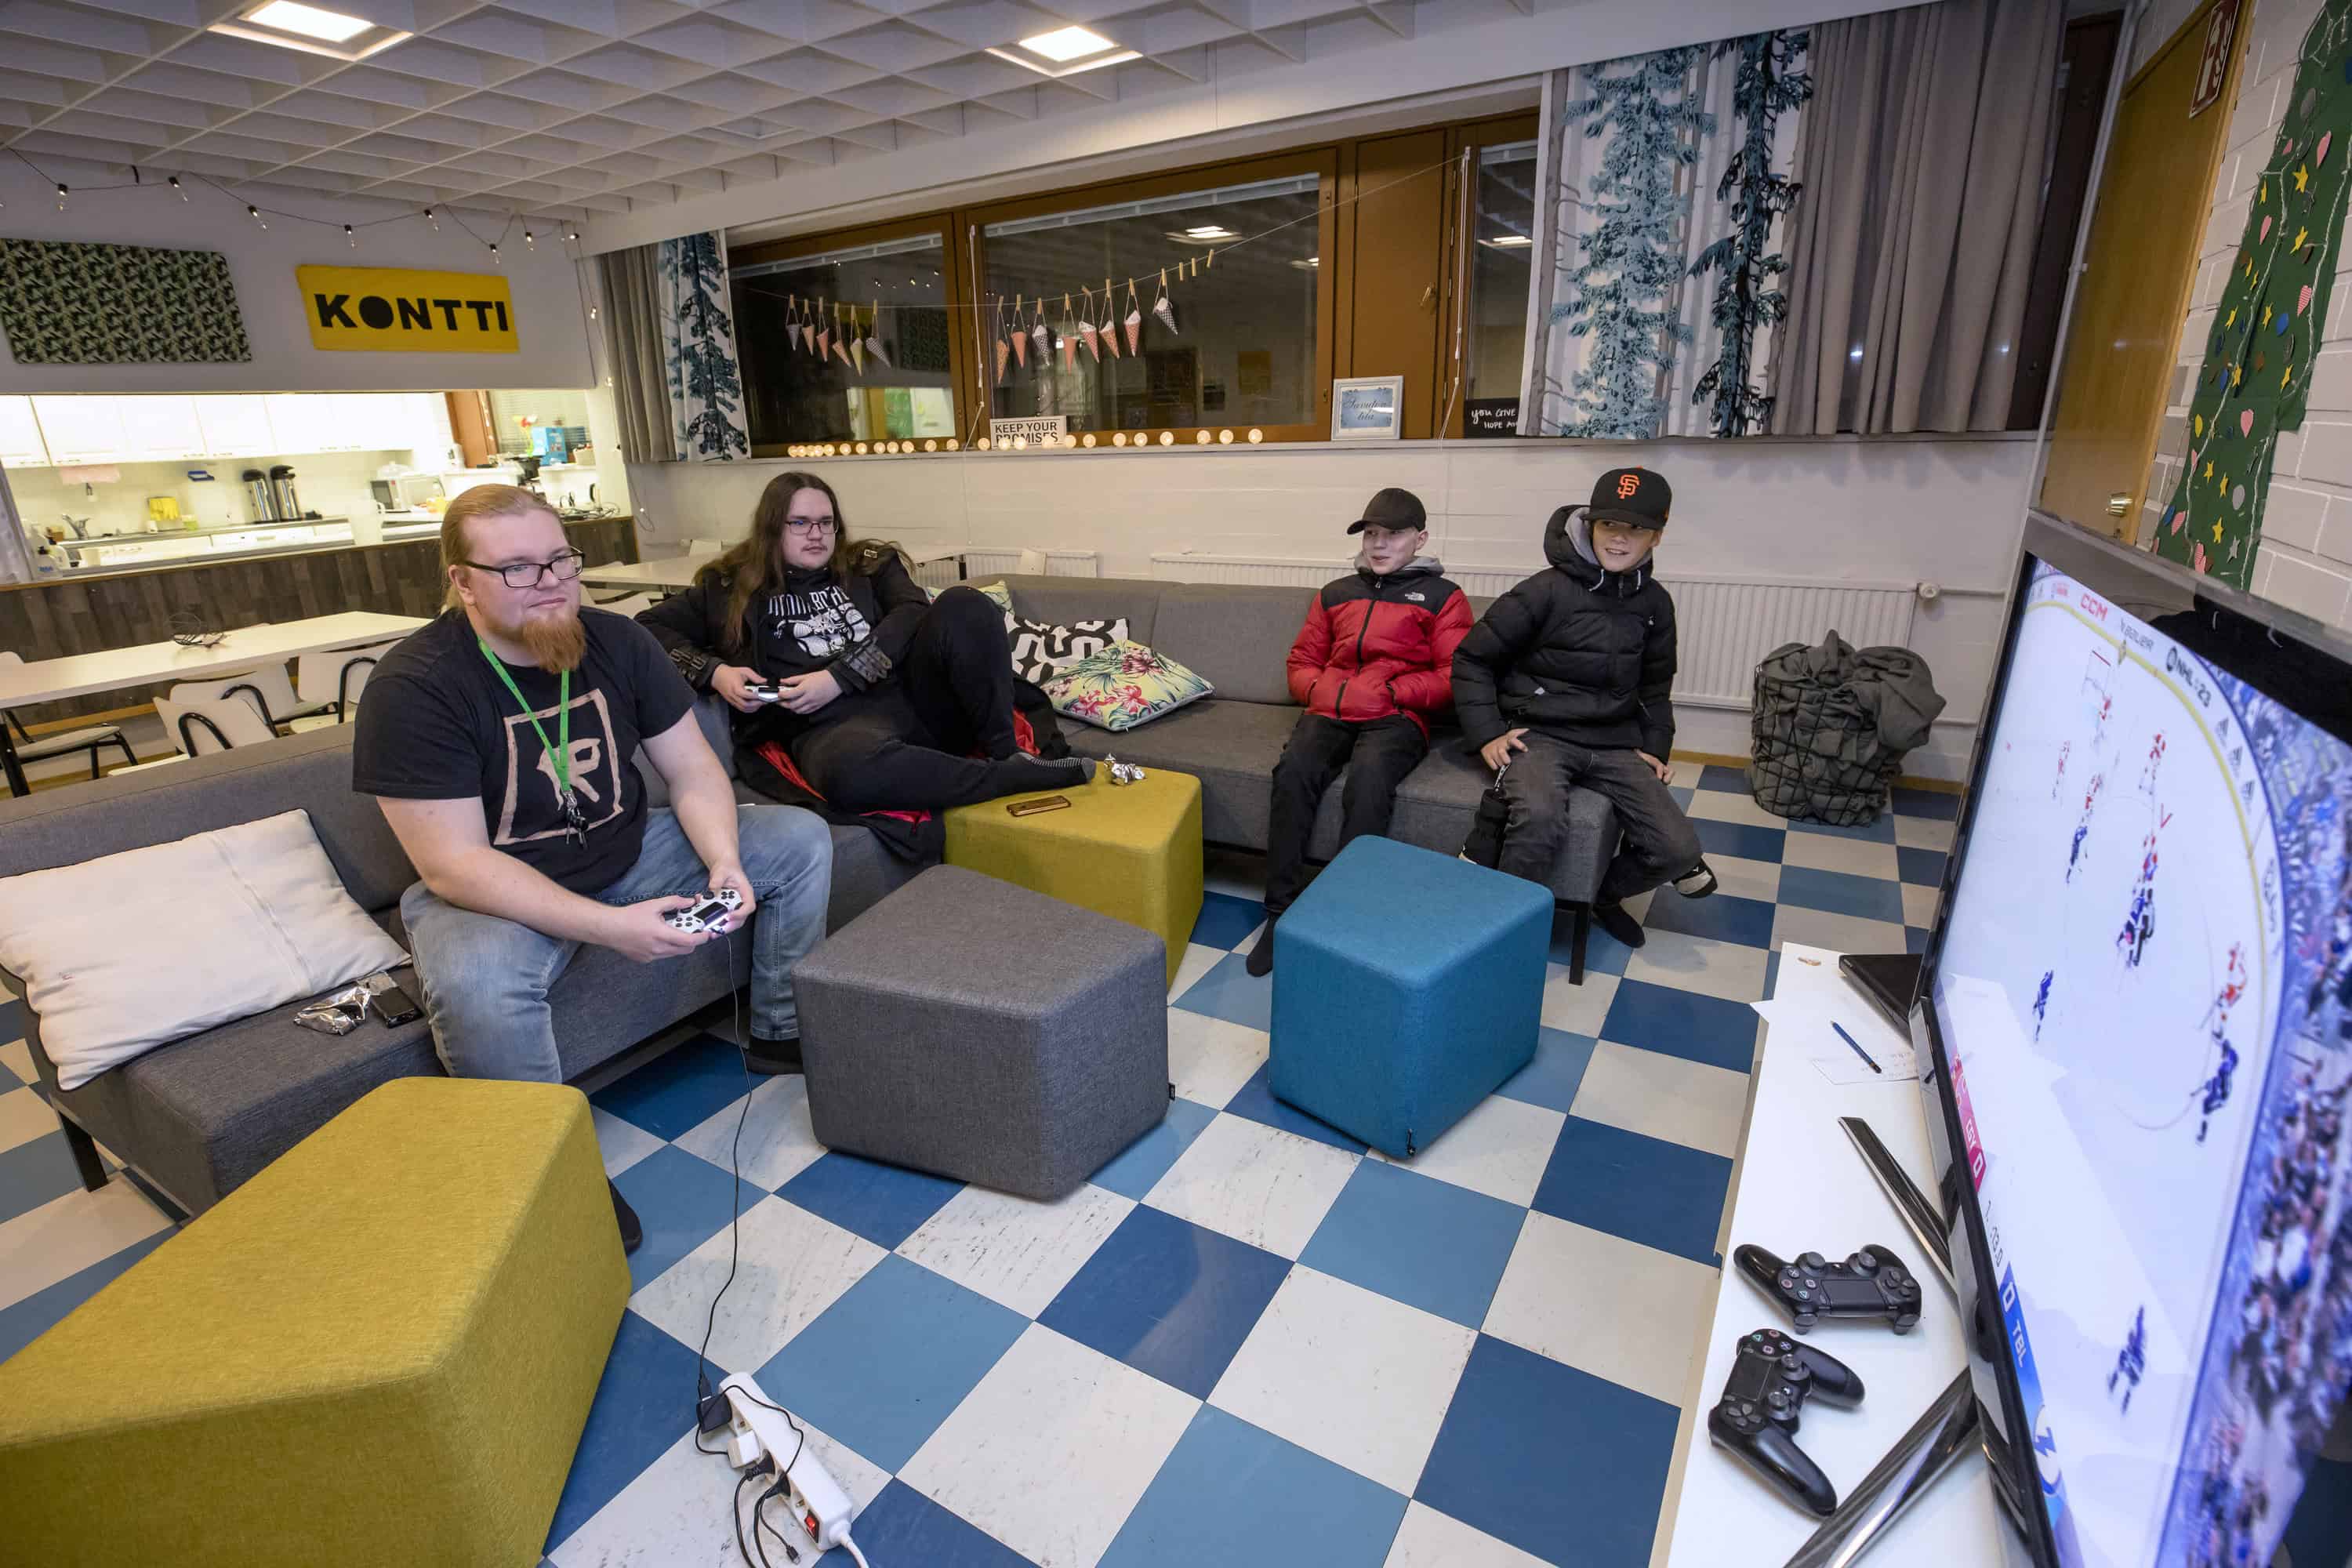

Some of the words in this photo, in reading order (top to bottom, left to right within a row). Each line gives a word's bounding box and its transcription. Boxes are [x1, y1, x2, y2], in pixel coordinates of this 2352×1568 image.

[314, 293, 509, 332] KONTTI
[995, 423, 1023, 433] KEEP
[1026, 422, 1057, 431] YOUR
[2081, 593, 2108, 621] CCM
